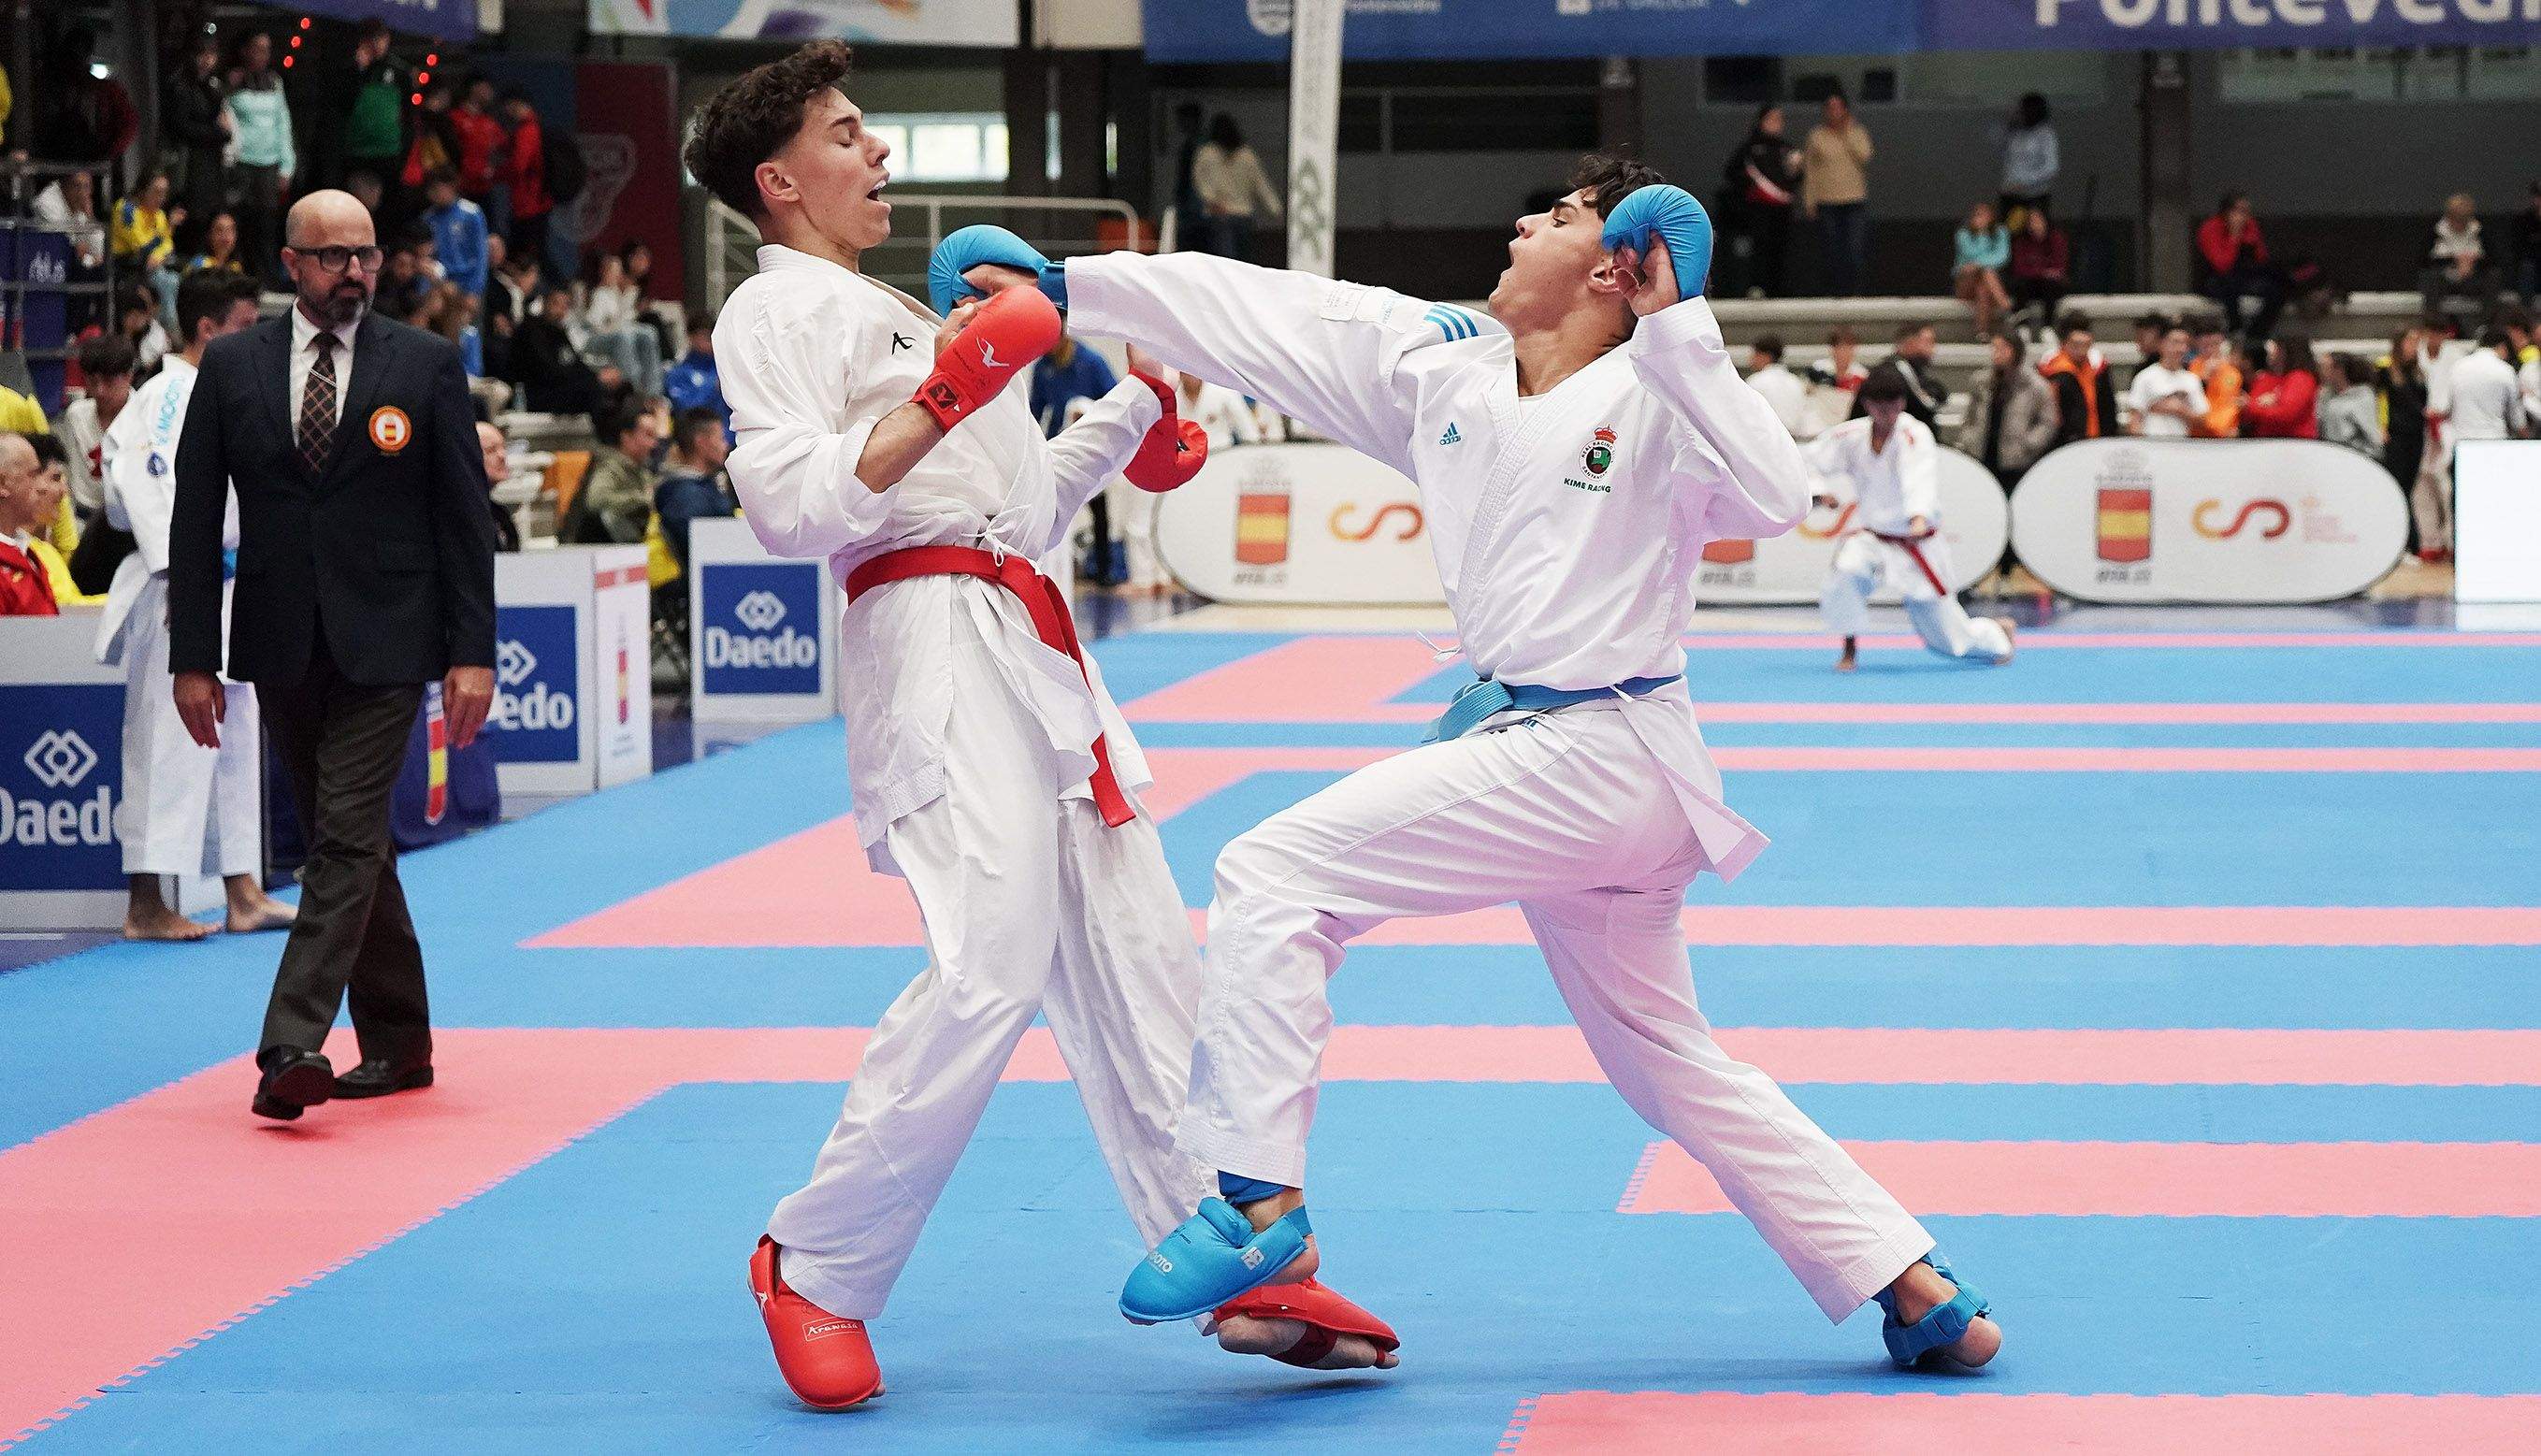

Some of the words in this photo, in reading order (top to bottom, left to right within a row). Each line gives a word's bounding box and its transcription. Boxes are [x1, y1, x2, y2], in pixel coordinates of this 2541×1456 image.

[1564, 477, 1587, 490] KIME
[705, 625, 816, 669] Daedo
[487, 681, 574, 730] edo
